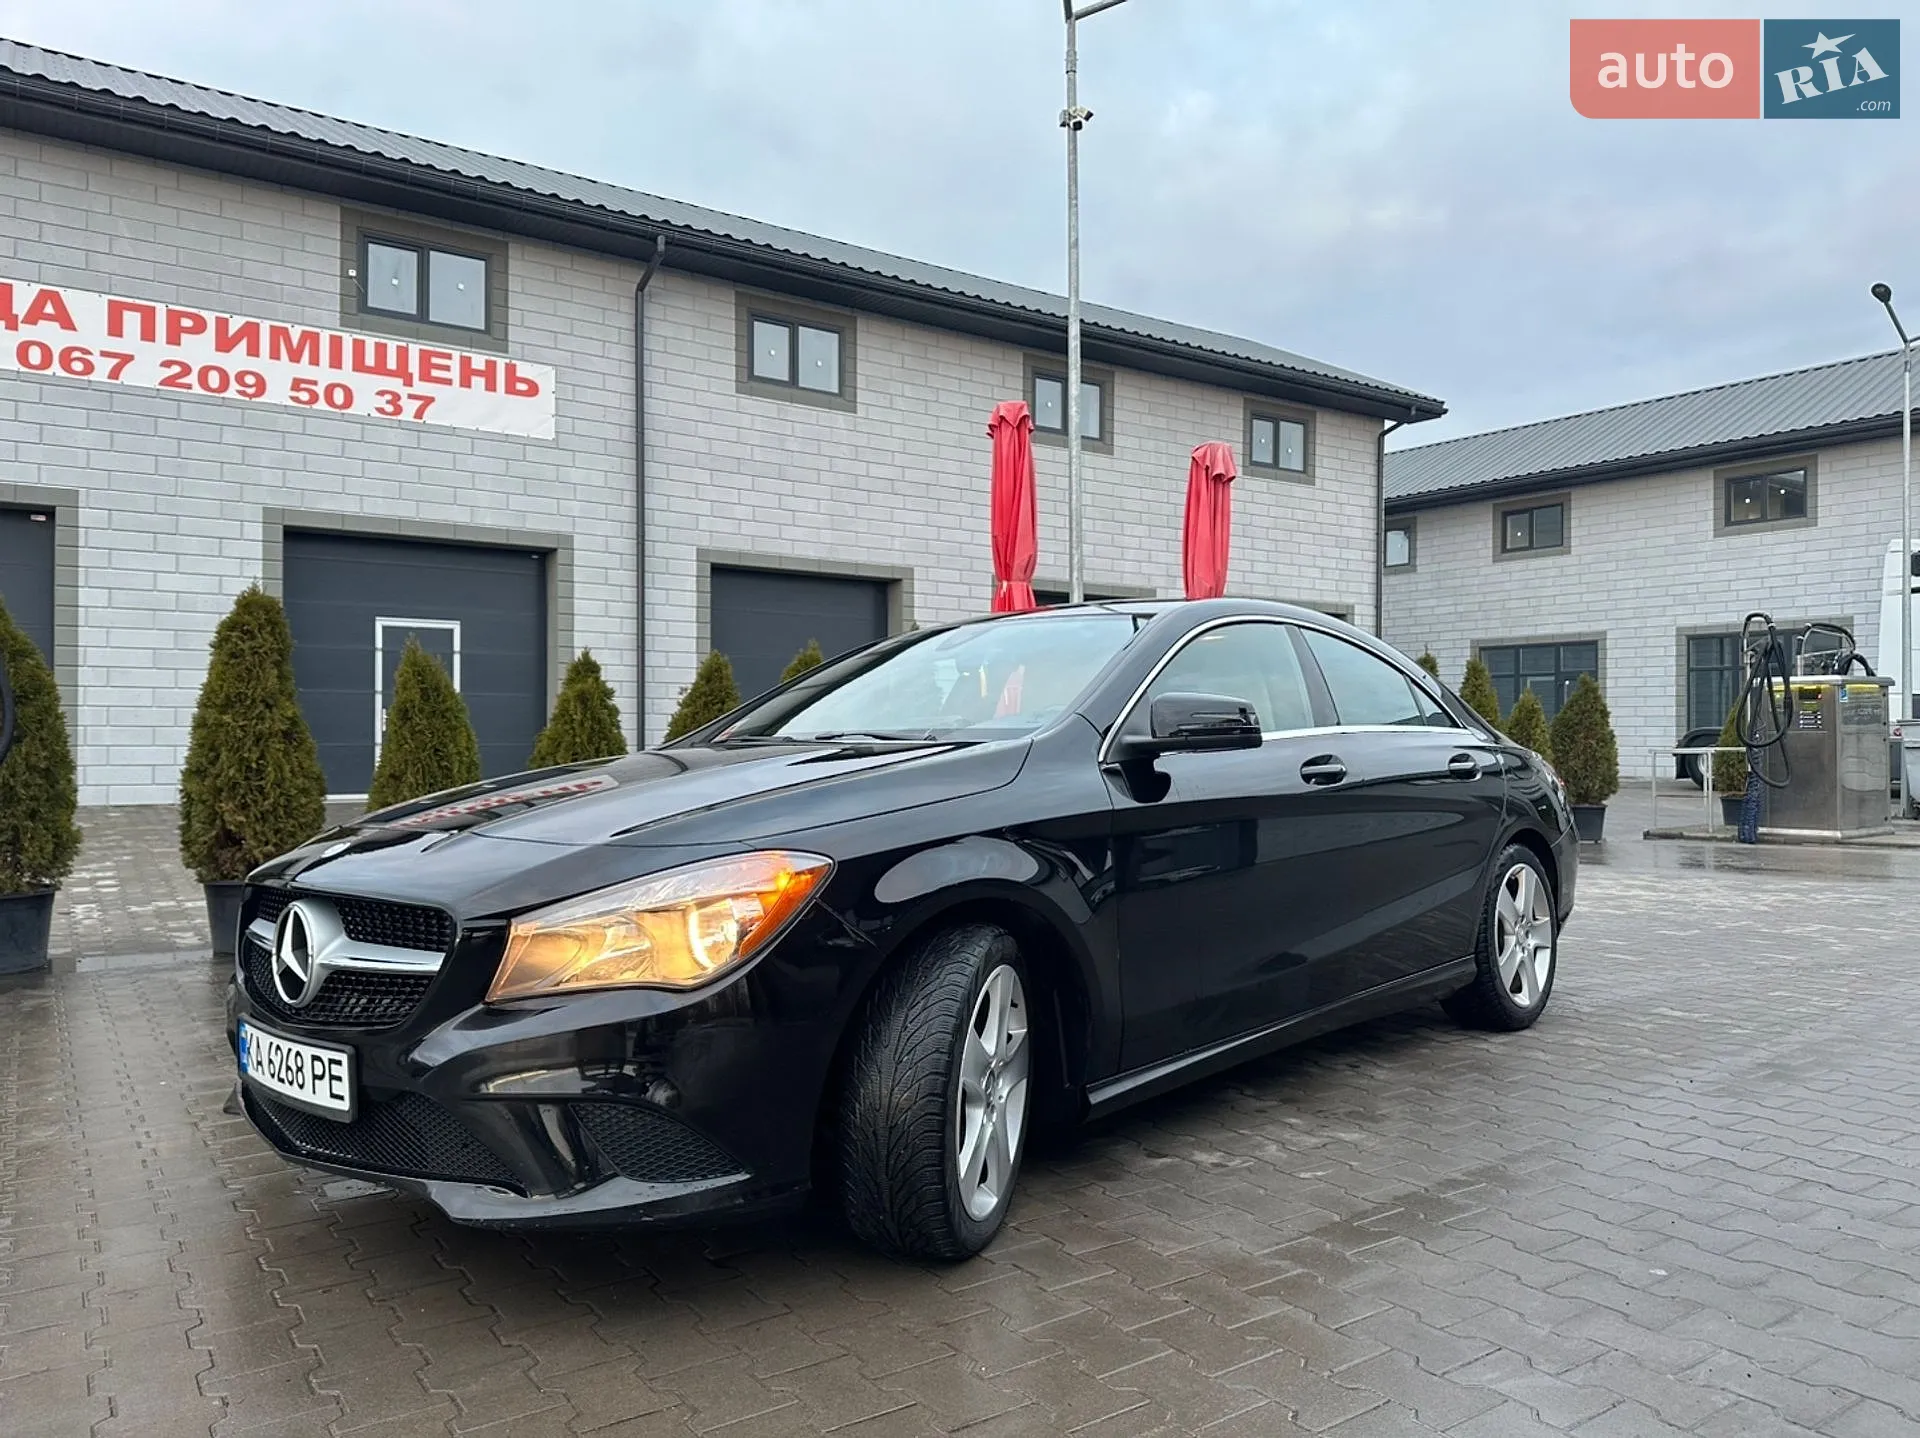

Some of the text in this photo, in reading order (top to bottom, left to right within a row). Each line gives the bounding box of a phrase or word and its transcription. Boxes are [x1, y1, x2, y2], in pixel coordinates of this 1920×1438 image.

[16, 339, 436, 420] 067 209 50 37
[107, 298, 540, 398] ПРИМІЩЕНЬ
[268, 1041, 305, 1090] 6268
[310, 1054, 345, 1101] PE
